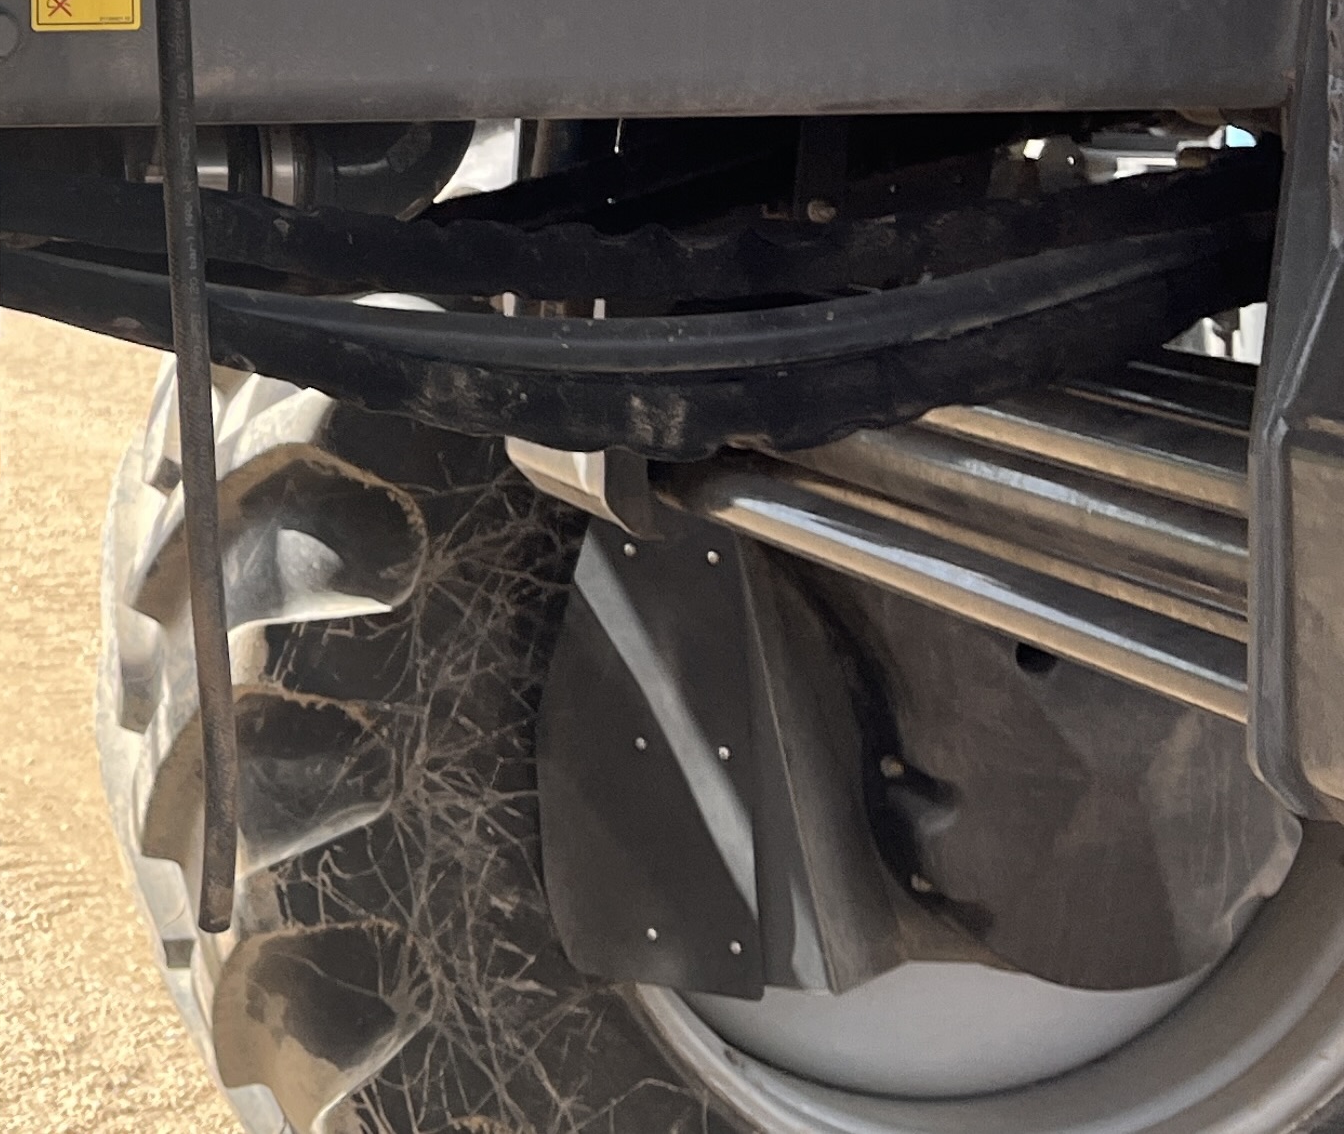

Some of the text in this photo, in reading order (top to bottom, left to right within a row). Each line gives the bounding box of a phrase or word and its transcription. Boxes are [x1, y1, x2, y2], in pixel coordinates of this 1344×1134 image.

[176, 72, 188, 98] USA
[178, 106, 189, 123] IN
[184, 202, 194, 226] MAX
